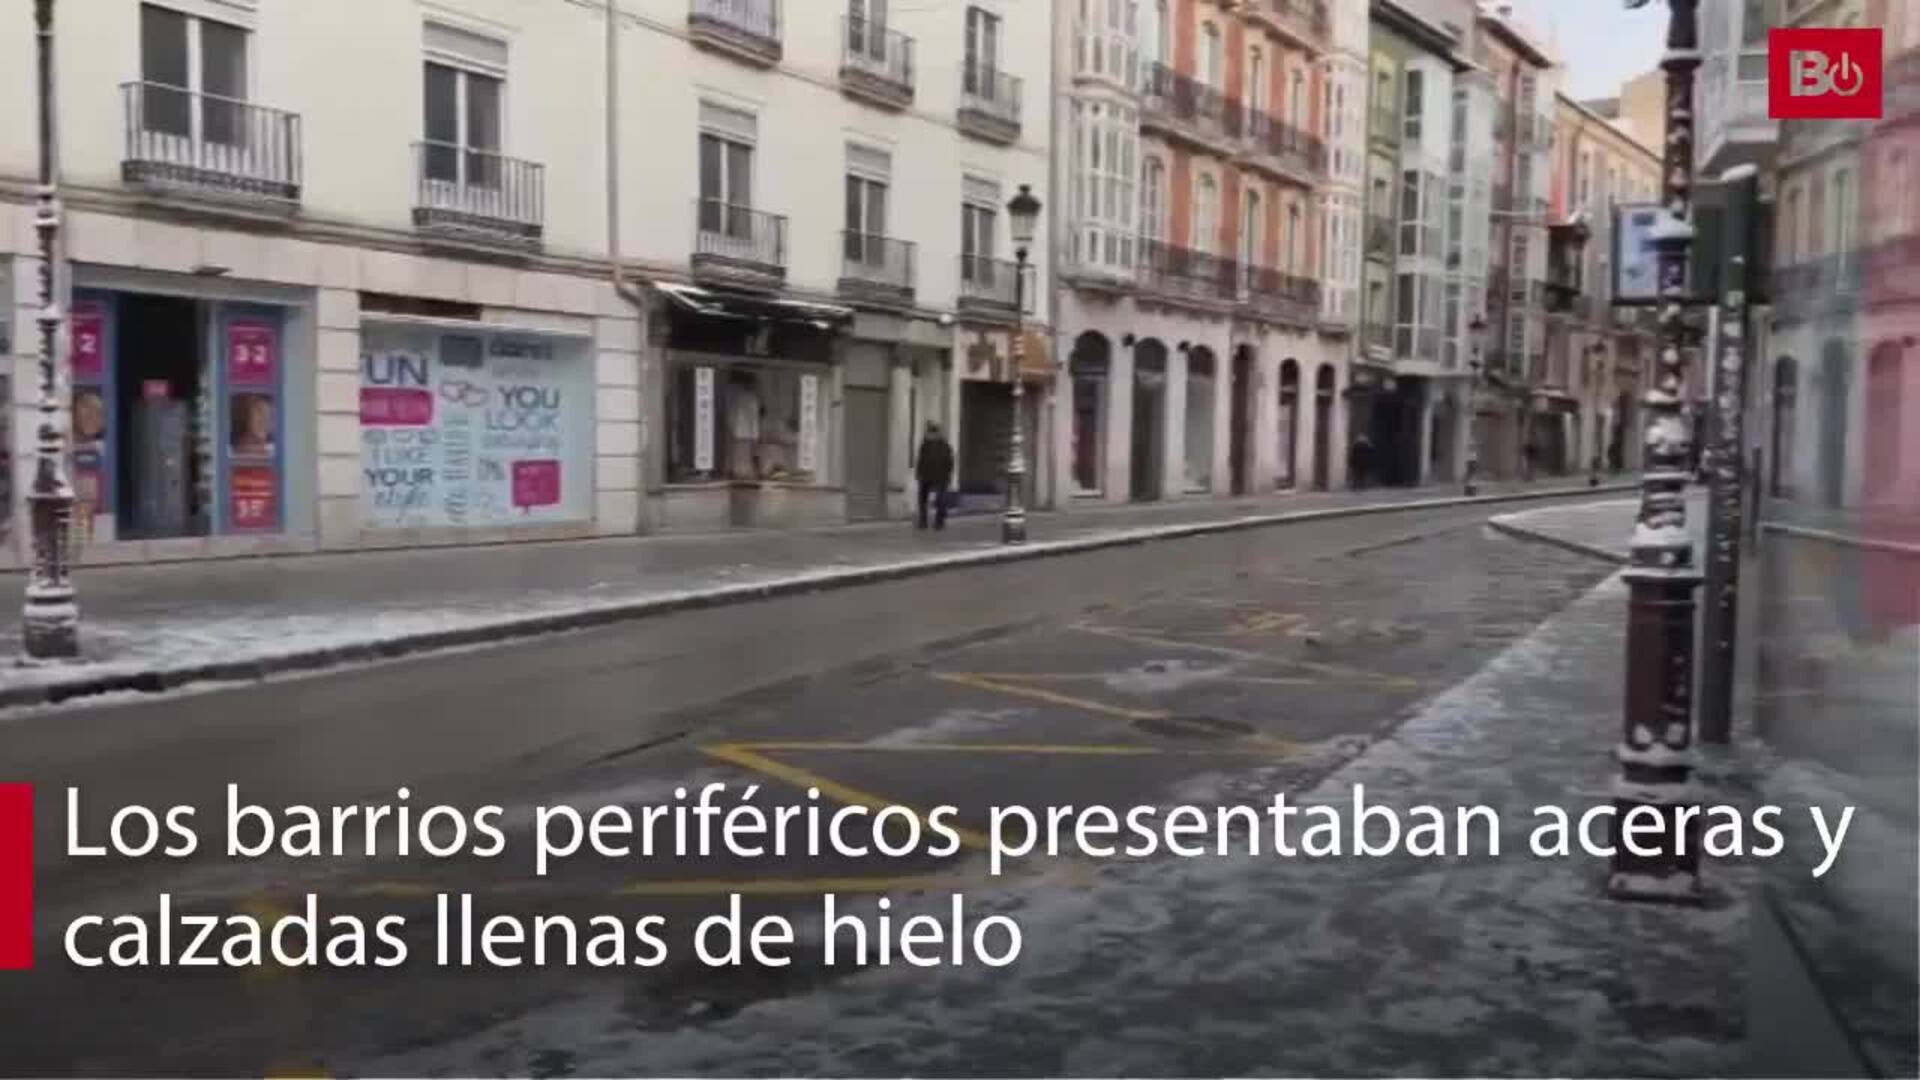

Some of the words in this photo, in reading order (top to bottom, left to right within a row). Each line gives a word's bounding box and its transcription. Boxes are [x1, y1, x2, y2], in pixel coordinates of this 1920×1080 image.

[498, 386, 560, 409] YOU
[485, 408, 562, 431] LOOK
[363, 468, 433, 487] YOUR
